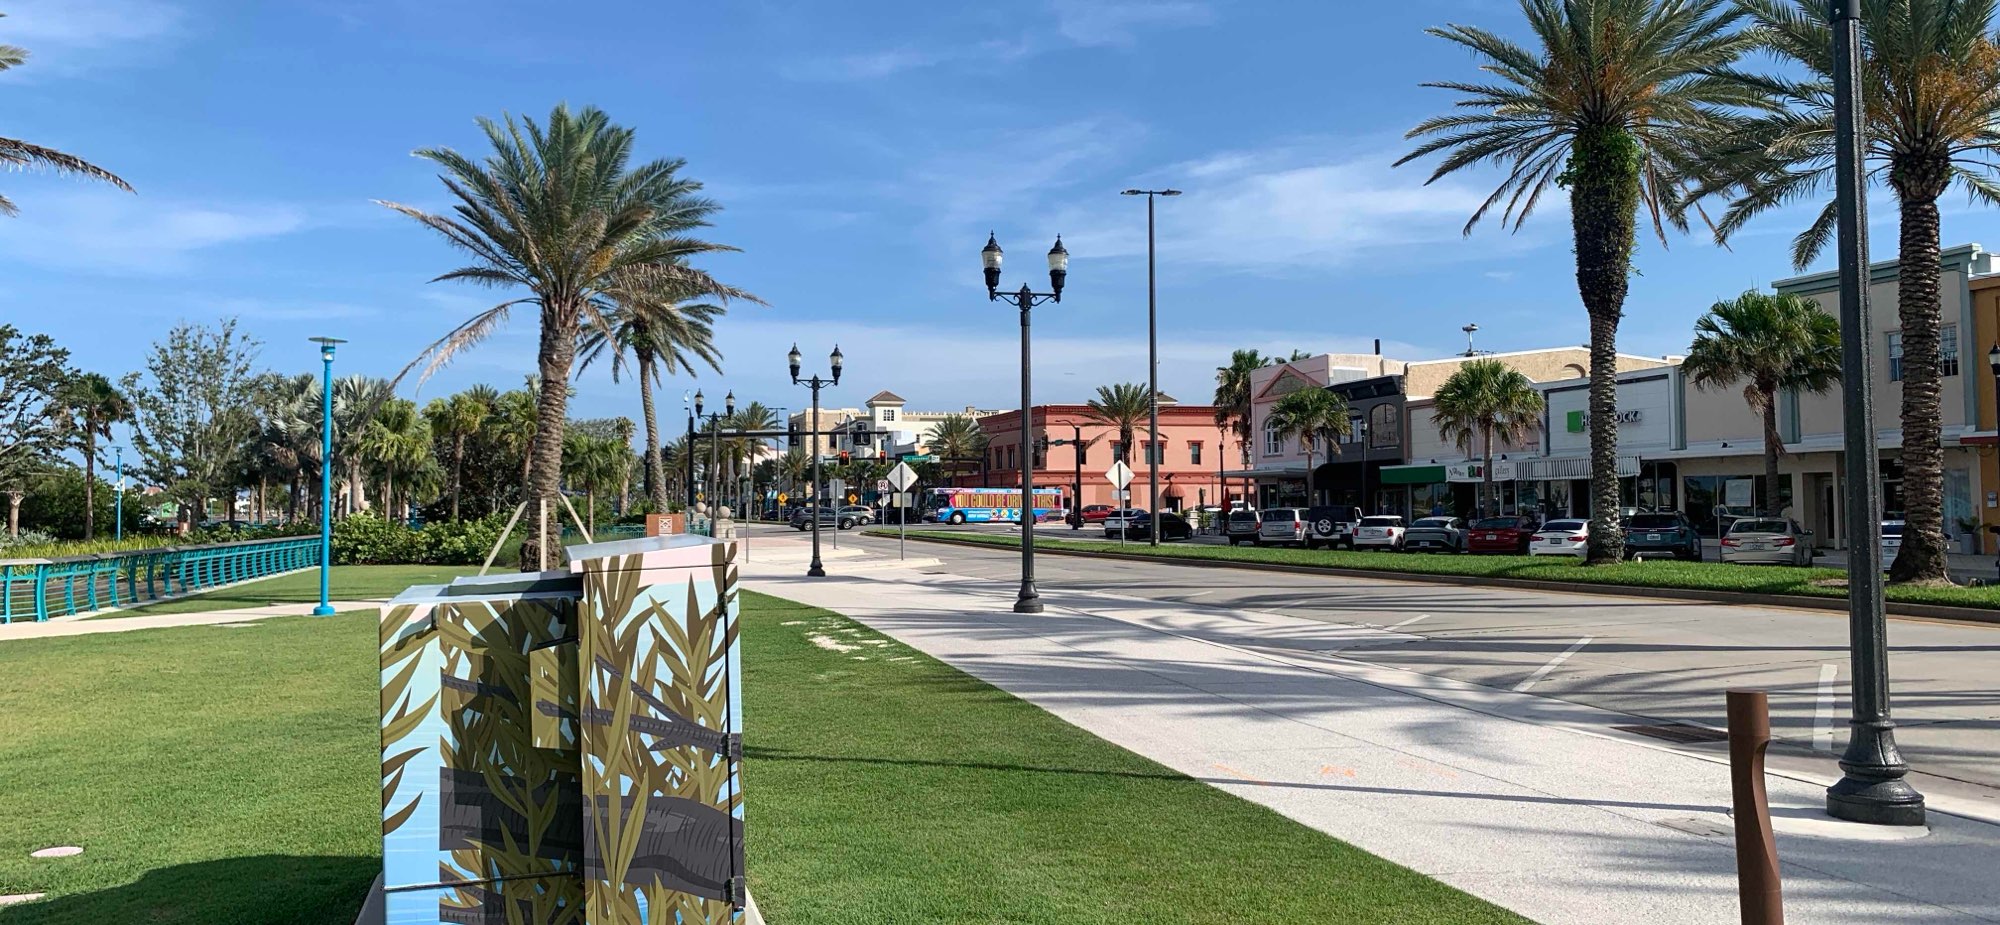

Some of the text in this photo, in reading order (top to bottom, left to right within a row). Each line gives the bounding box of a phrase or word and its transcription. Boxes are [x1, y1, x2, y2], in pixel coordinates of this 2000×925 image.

[954, 494, 969, 507] YOU
[971, 494, 994, 507] COULD
[996, 494, 1006, 508] BE
[1037, 494, 1055, 508] THIS!
